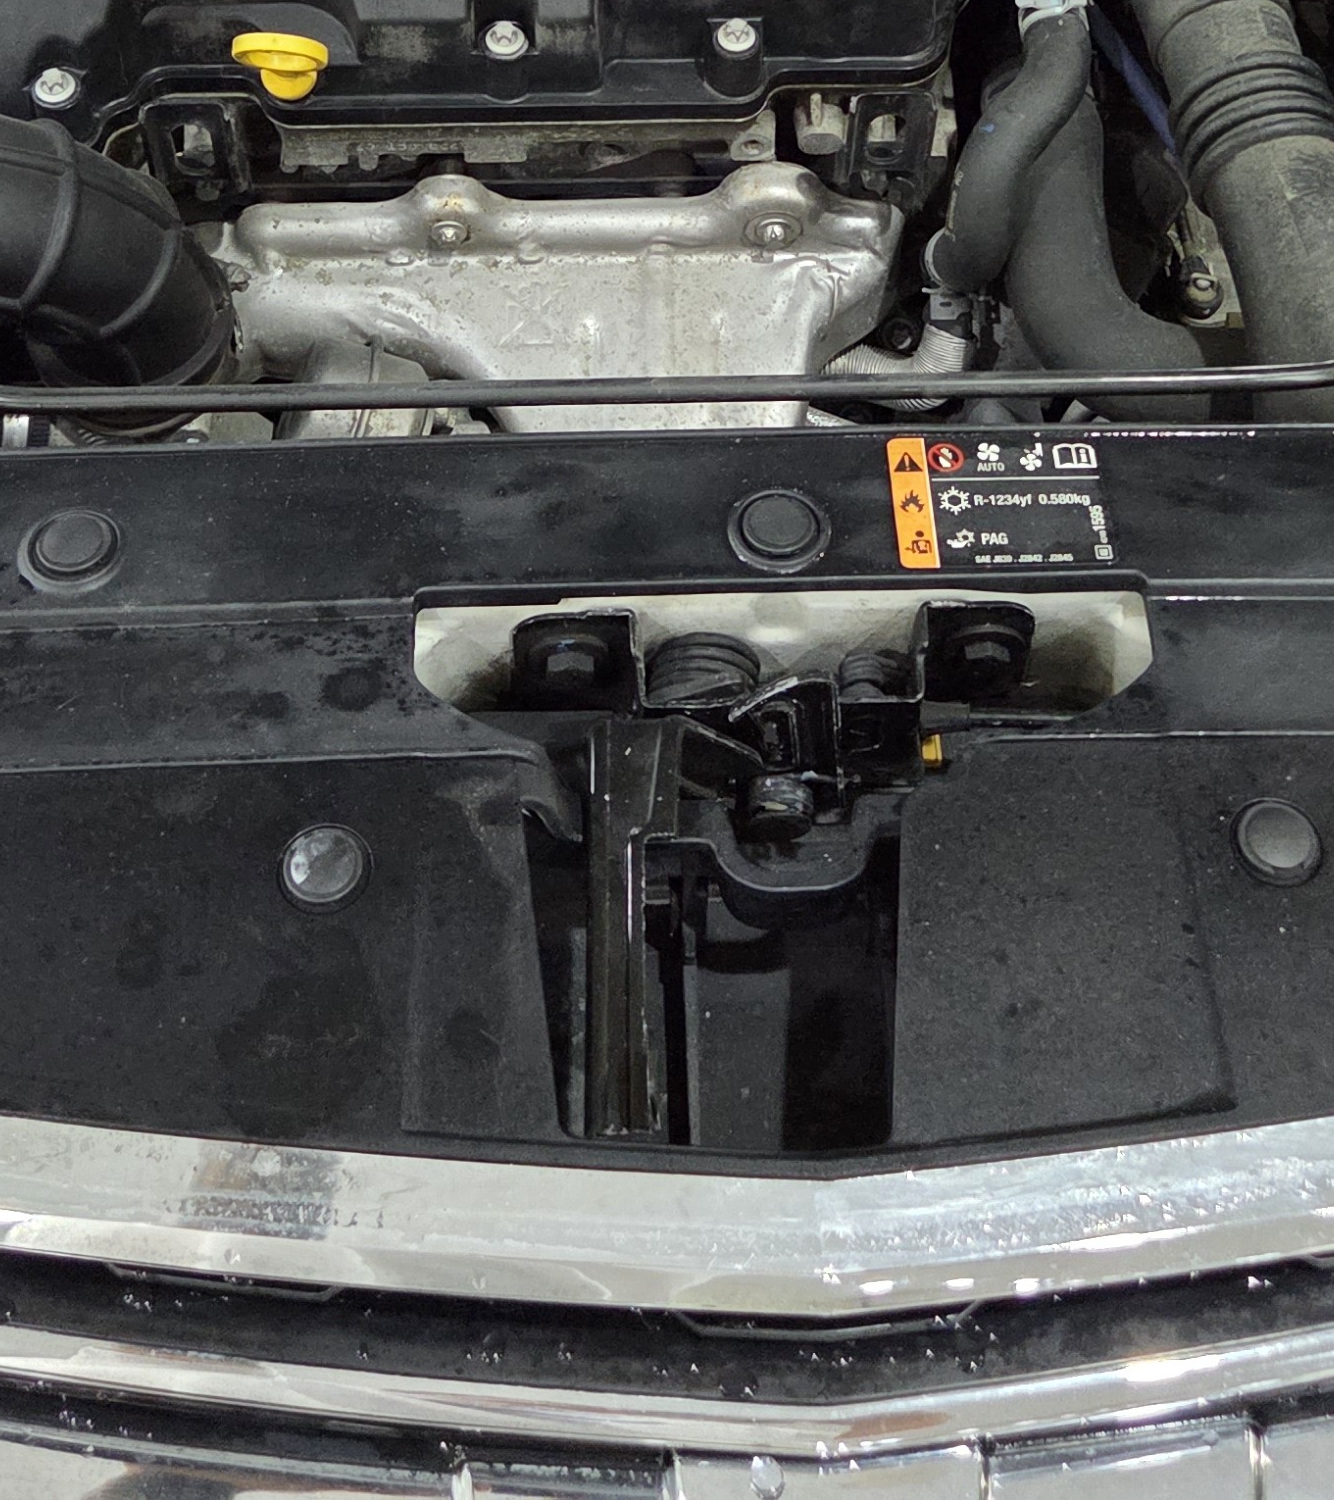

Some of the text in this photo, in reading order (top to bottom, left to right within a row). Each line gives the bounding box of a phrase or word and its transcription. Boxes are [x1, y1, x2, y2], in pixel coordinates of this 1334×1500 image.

[977, 462, 1005, 472] AUTO
[973, 493, 1091, 507] R-1234yf 0.580kg
[981, 532, 1009, 545] PAG
